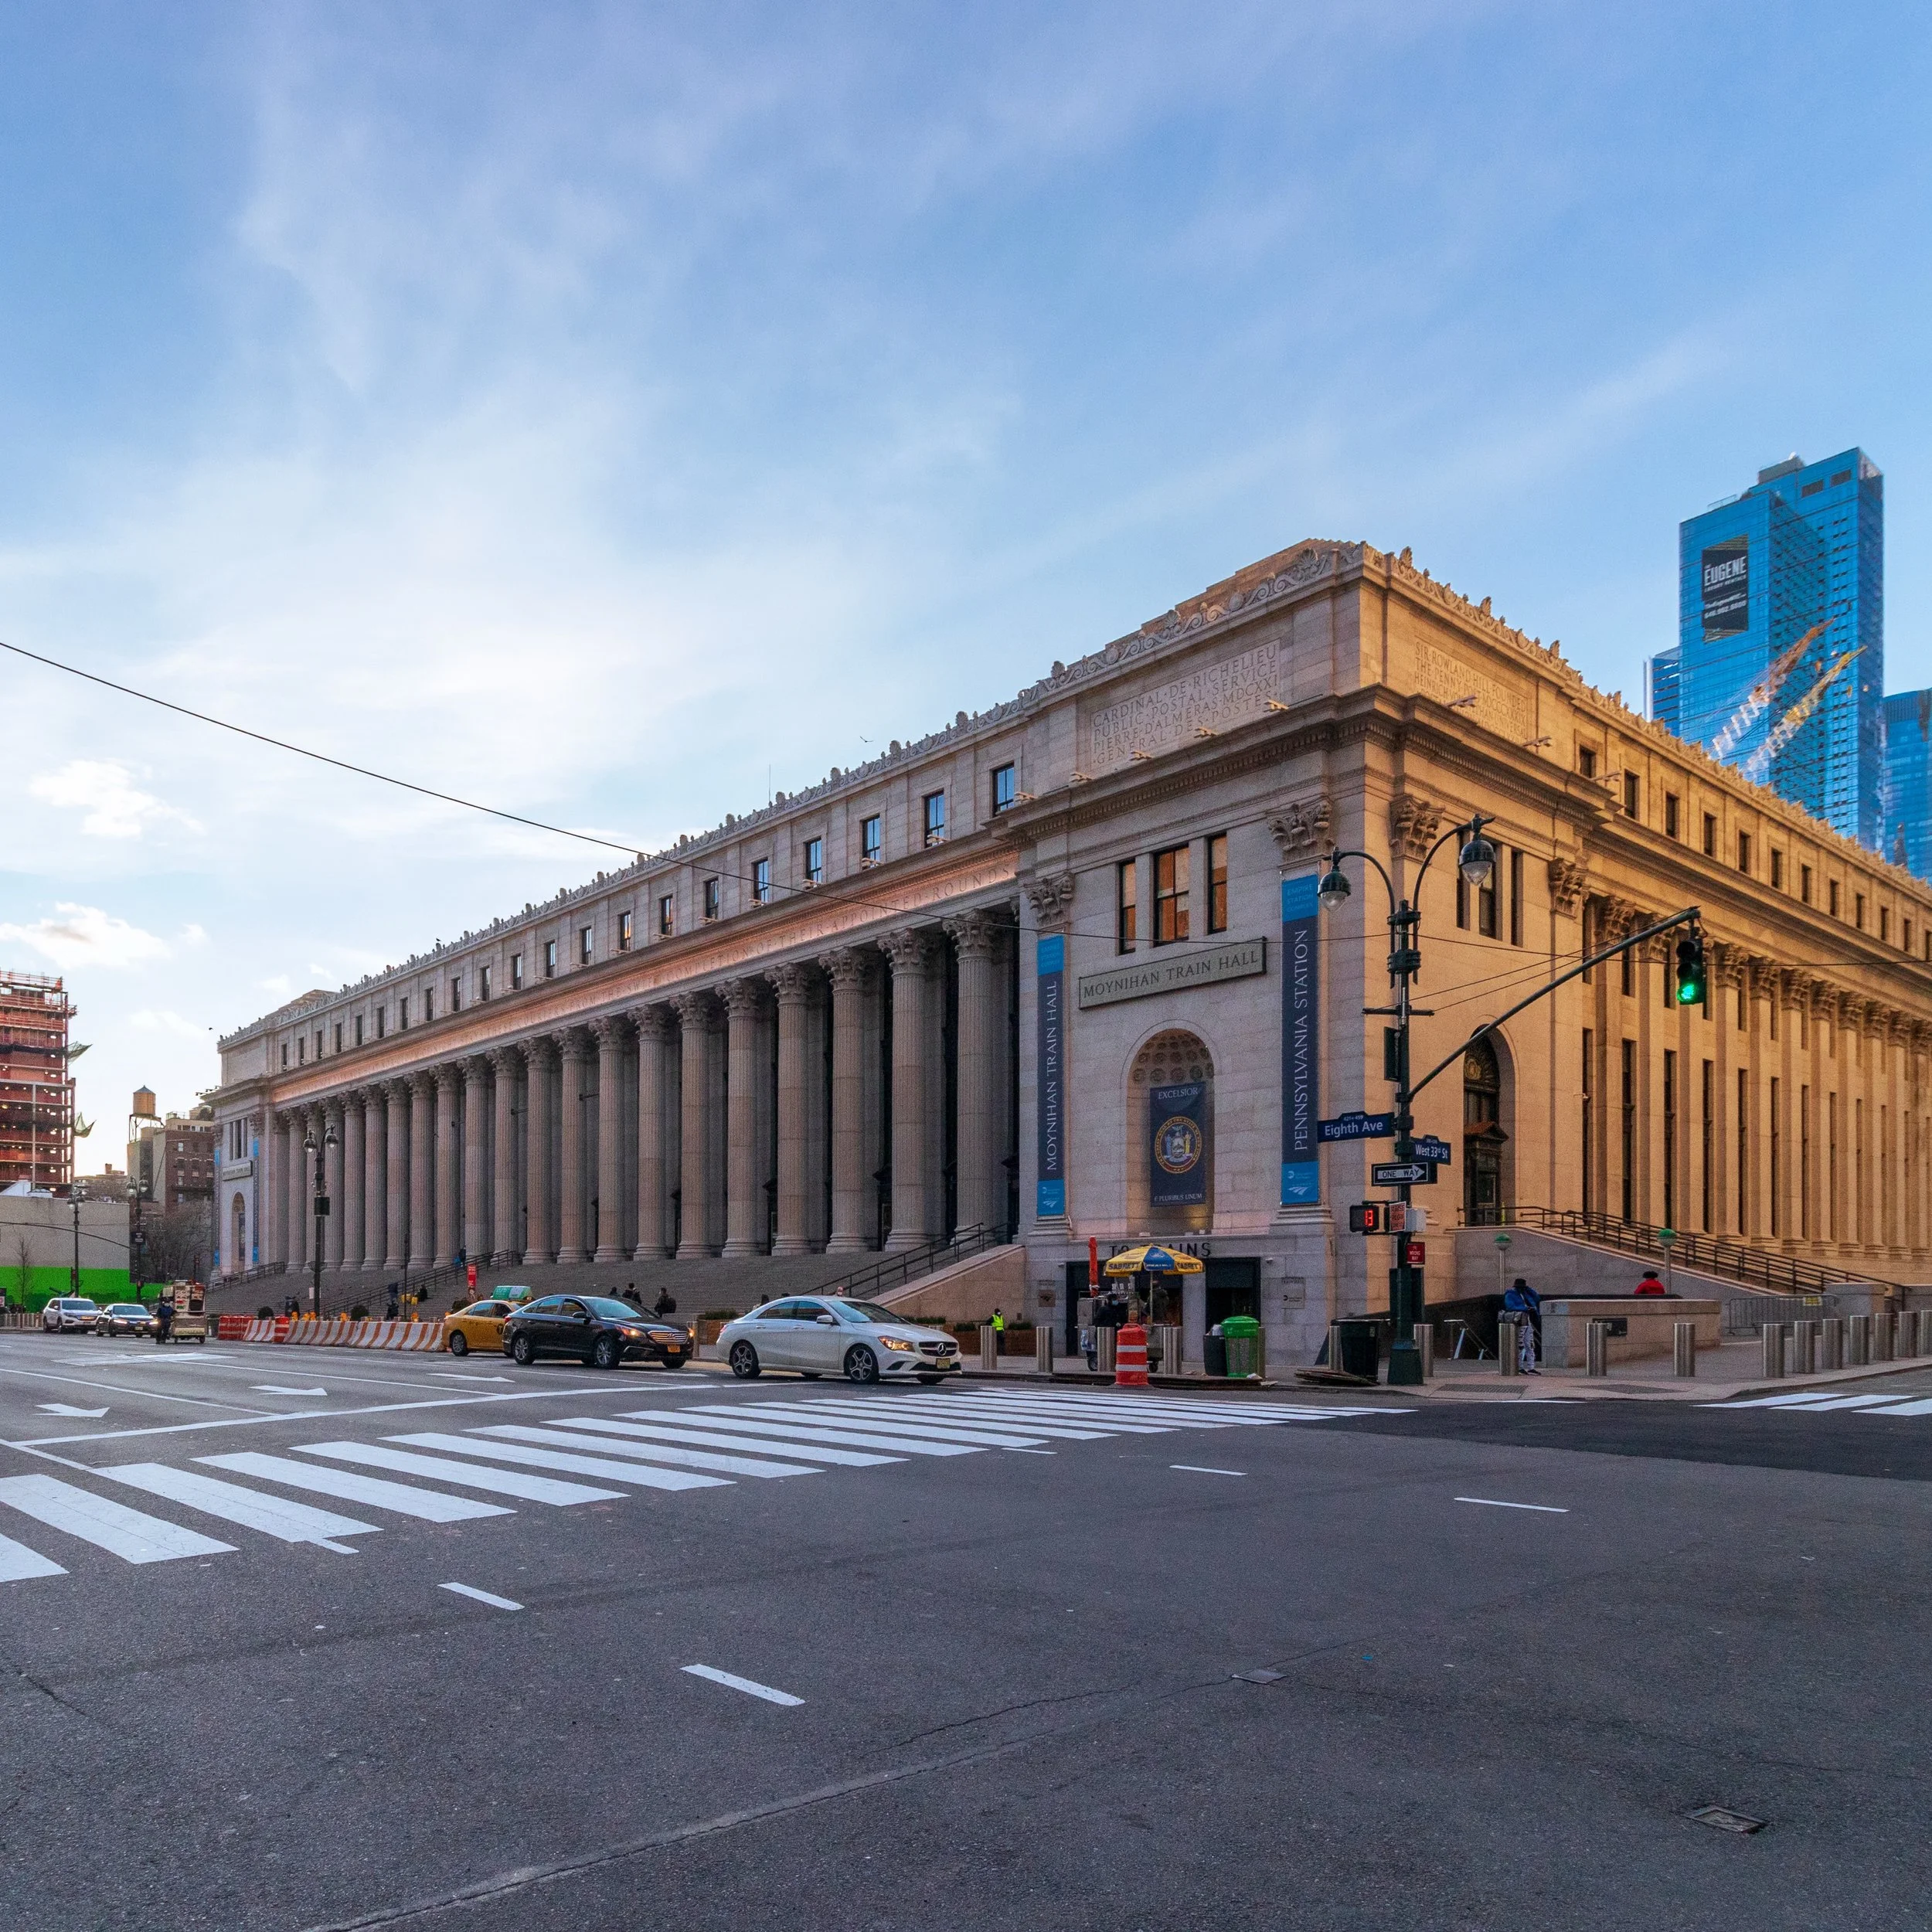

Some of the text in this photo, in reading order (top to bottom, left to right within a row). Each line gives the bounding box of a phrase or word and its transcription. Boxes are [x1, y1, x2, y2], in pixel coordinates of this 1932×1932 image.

[1705, 556, 1747, 587] EUGENE
[1094, 644, 1276, 727] CARDINAL DE RICHELIEU
[1415, 641, 1430, 661] SIR
[1431, 651, 1471, 683] ROWLAND
[1473, 672, 1491, 694] HILL
[1415, 657, 1431, 676] THE
[1434, 667, 1462, 692] PENNY
[1094, 660, 1276, 742] PUBLIC POSTAL SERVICE
[1094, 727, 1139, 753] PIERRE
[1223, 674, 1277, 705] MDCXXI
[932, 866, 1009, 903] ROUNDS
[1083, 951, 1258, 999] MOYNIHAN TRAIN HALL
[1294, 930, 1308, 1151] PENNSYLVANIA STATION
[1046, 981, 1057, 1171] MOYNIHAN TRAIN HALL
[1158, 1087, 1198, 1099] EXCELSIOR
[1325, 1121, 1383, 1138] Eighth Ave
[1415, 1144, 1430, 1157] West
[1441, 1148, 1448, 1159] St
[1382, 1170, 1396, 1179] ONE
